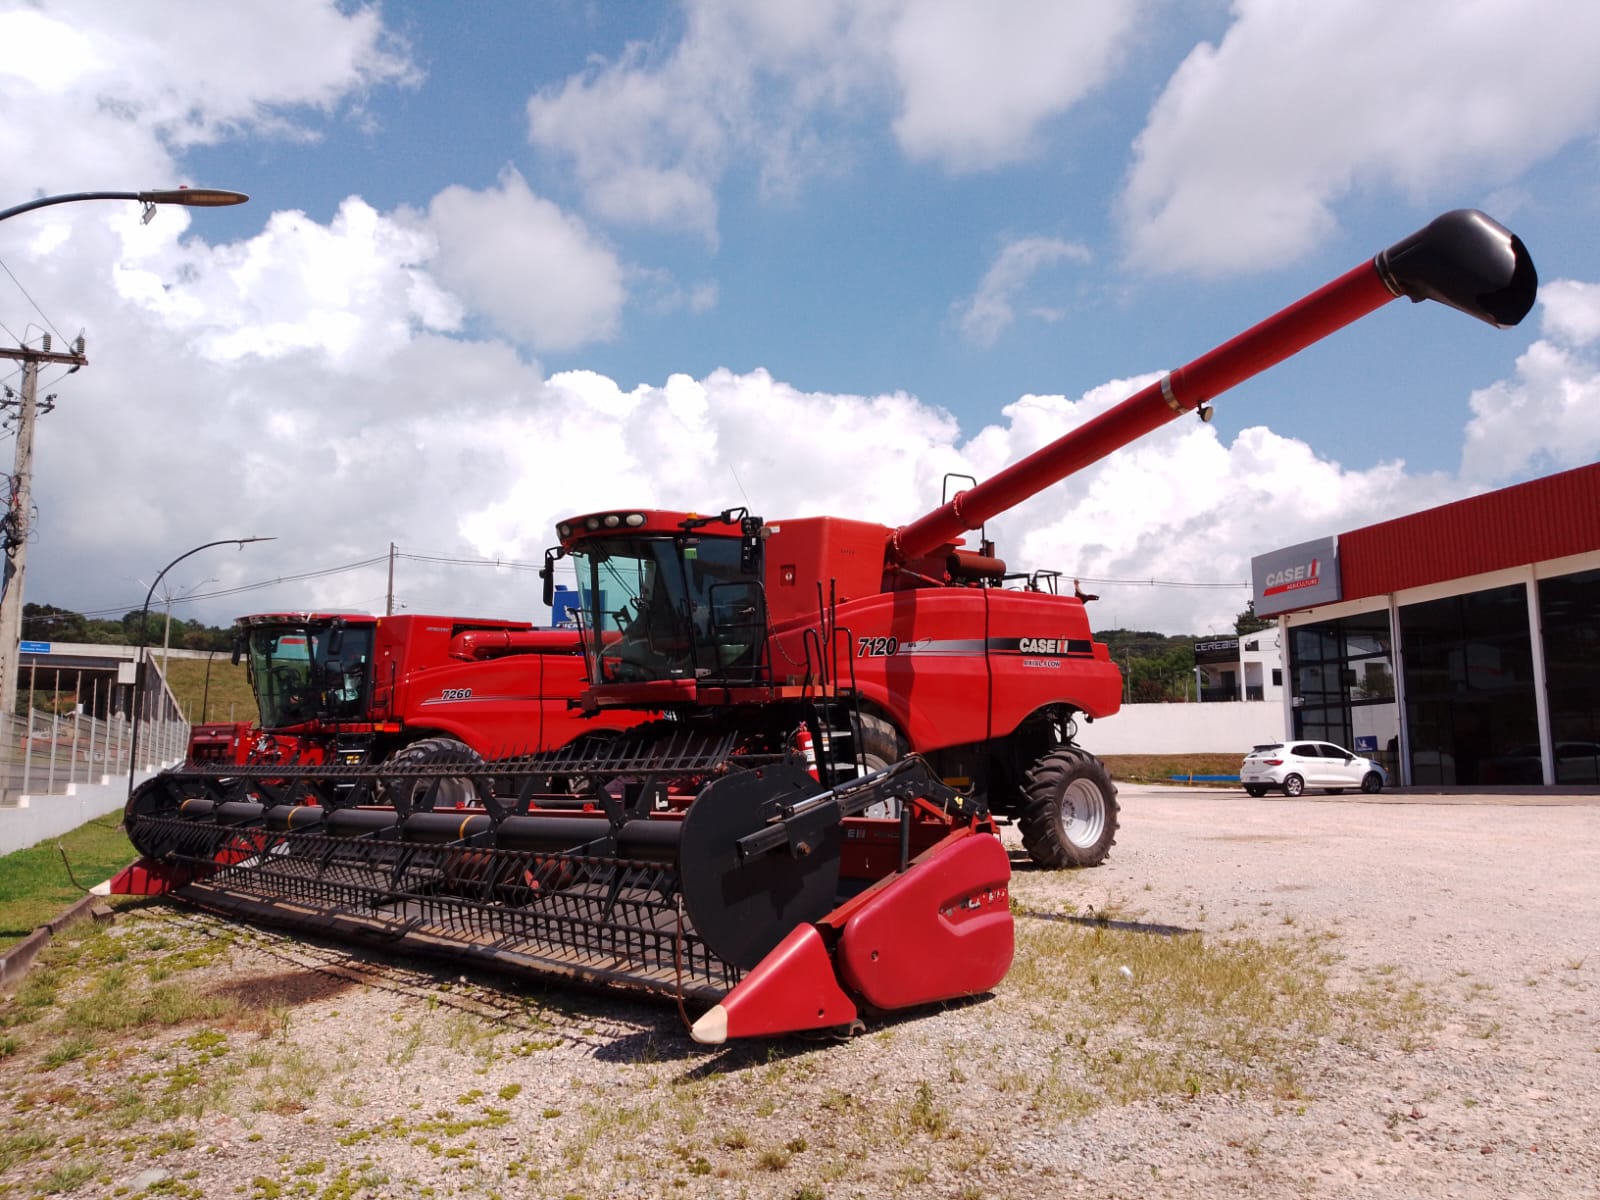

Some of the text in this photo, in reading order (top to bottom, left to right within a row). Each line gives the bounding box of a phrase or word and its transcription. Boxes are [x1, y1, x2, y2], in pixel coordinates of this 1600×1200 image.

[1266, 566, 1304, 586] CASE
[857, 636, 898, 657] 7120
[1019, 637, 1057, 654] CASE
[442, 688, 472, 700] 7260
